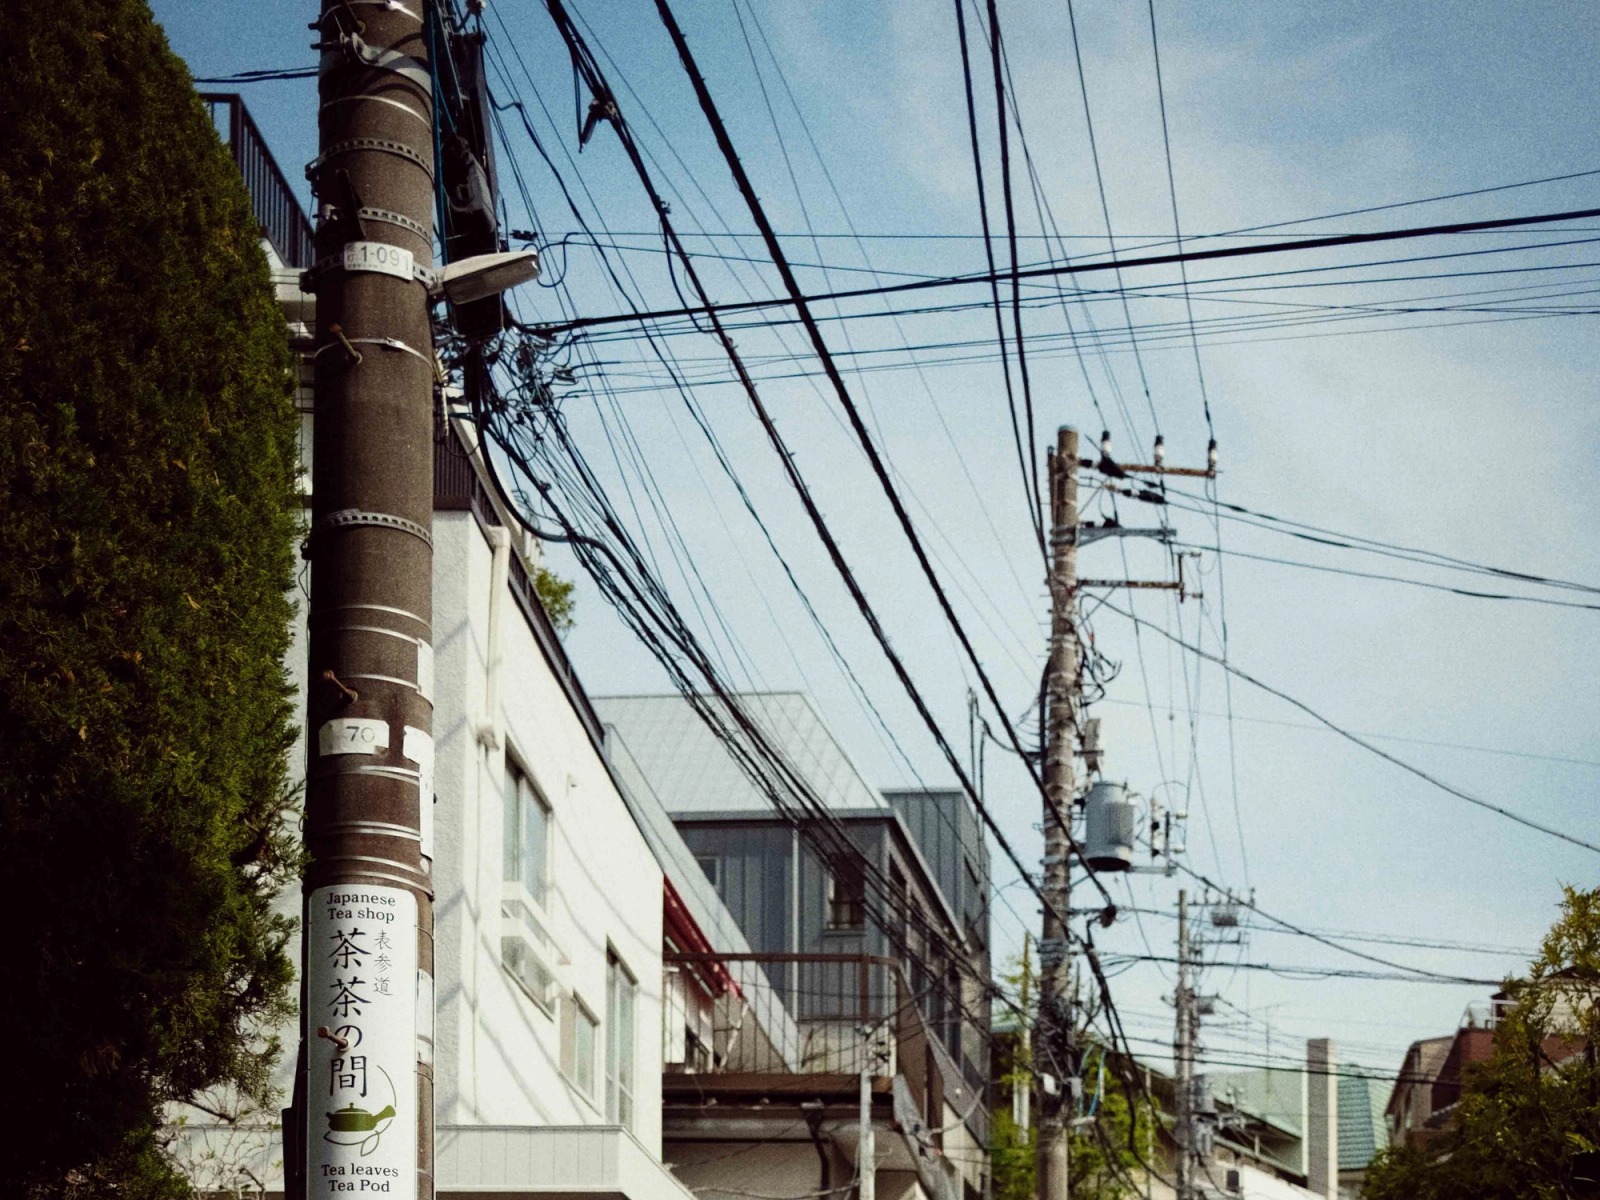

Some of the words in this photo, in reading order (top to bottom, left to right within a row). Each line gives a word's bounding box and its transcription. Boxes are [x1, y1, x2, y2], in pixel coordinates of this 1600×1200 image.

[346, 726, 375, 743] 70
[326, 893, 396, 906] Japanese
[328, 908, 353, 920] Tea
[357, 907, 395, 924] shop
[373, 929, 394, 996] 表参道
[327, 927, 372, 1097] 茶茶の間
[321, 1164, 346, 1176] Tea
[351, 1163, 399, 1177] leaves
[328, 1180, 355, 1192] Tea
[360, 1180, 390, 1192] Pod
